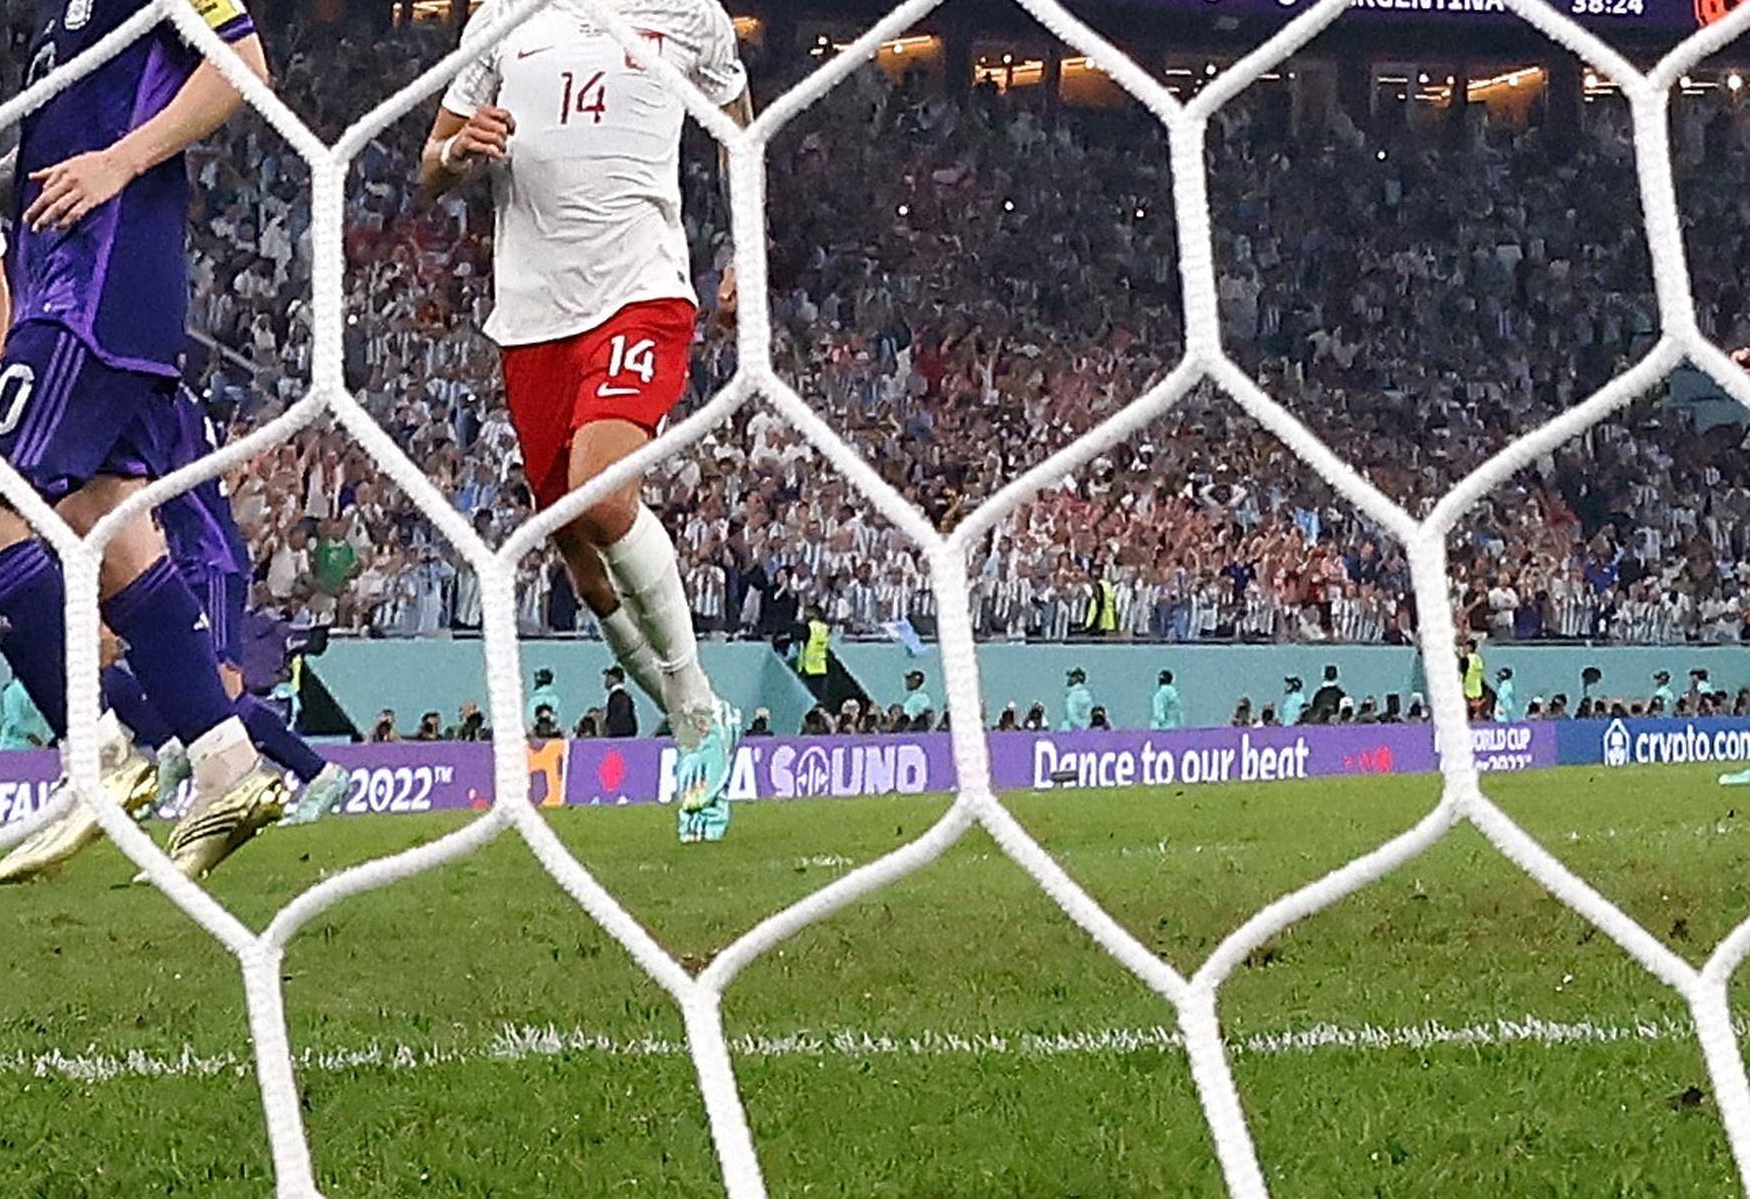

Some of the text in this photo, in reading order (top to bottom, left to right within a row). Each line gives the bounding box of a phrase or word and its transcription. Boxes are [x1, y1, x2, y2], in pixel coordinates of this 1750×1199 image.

[561, 71, 606, 124] 14
[609, 335, 654, 383] 14
[1034, 734, 1310, 789] Dance to our beat
